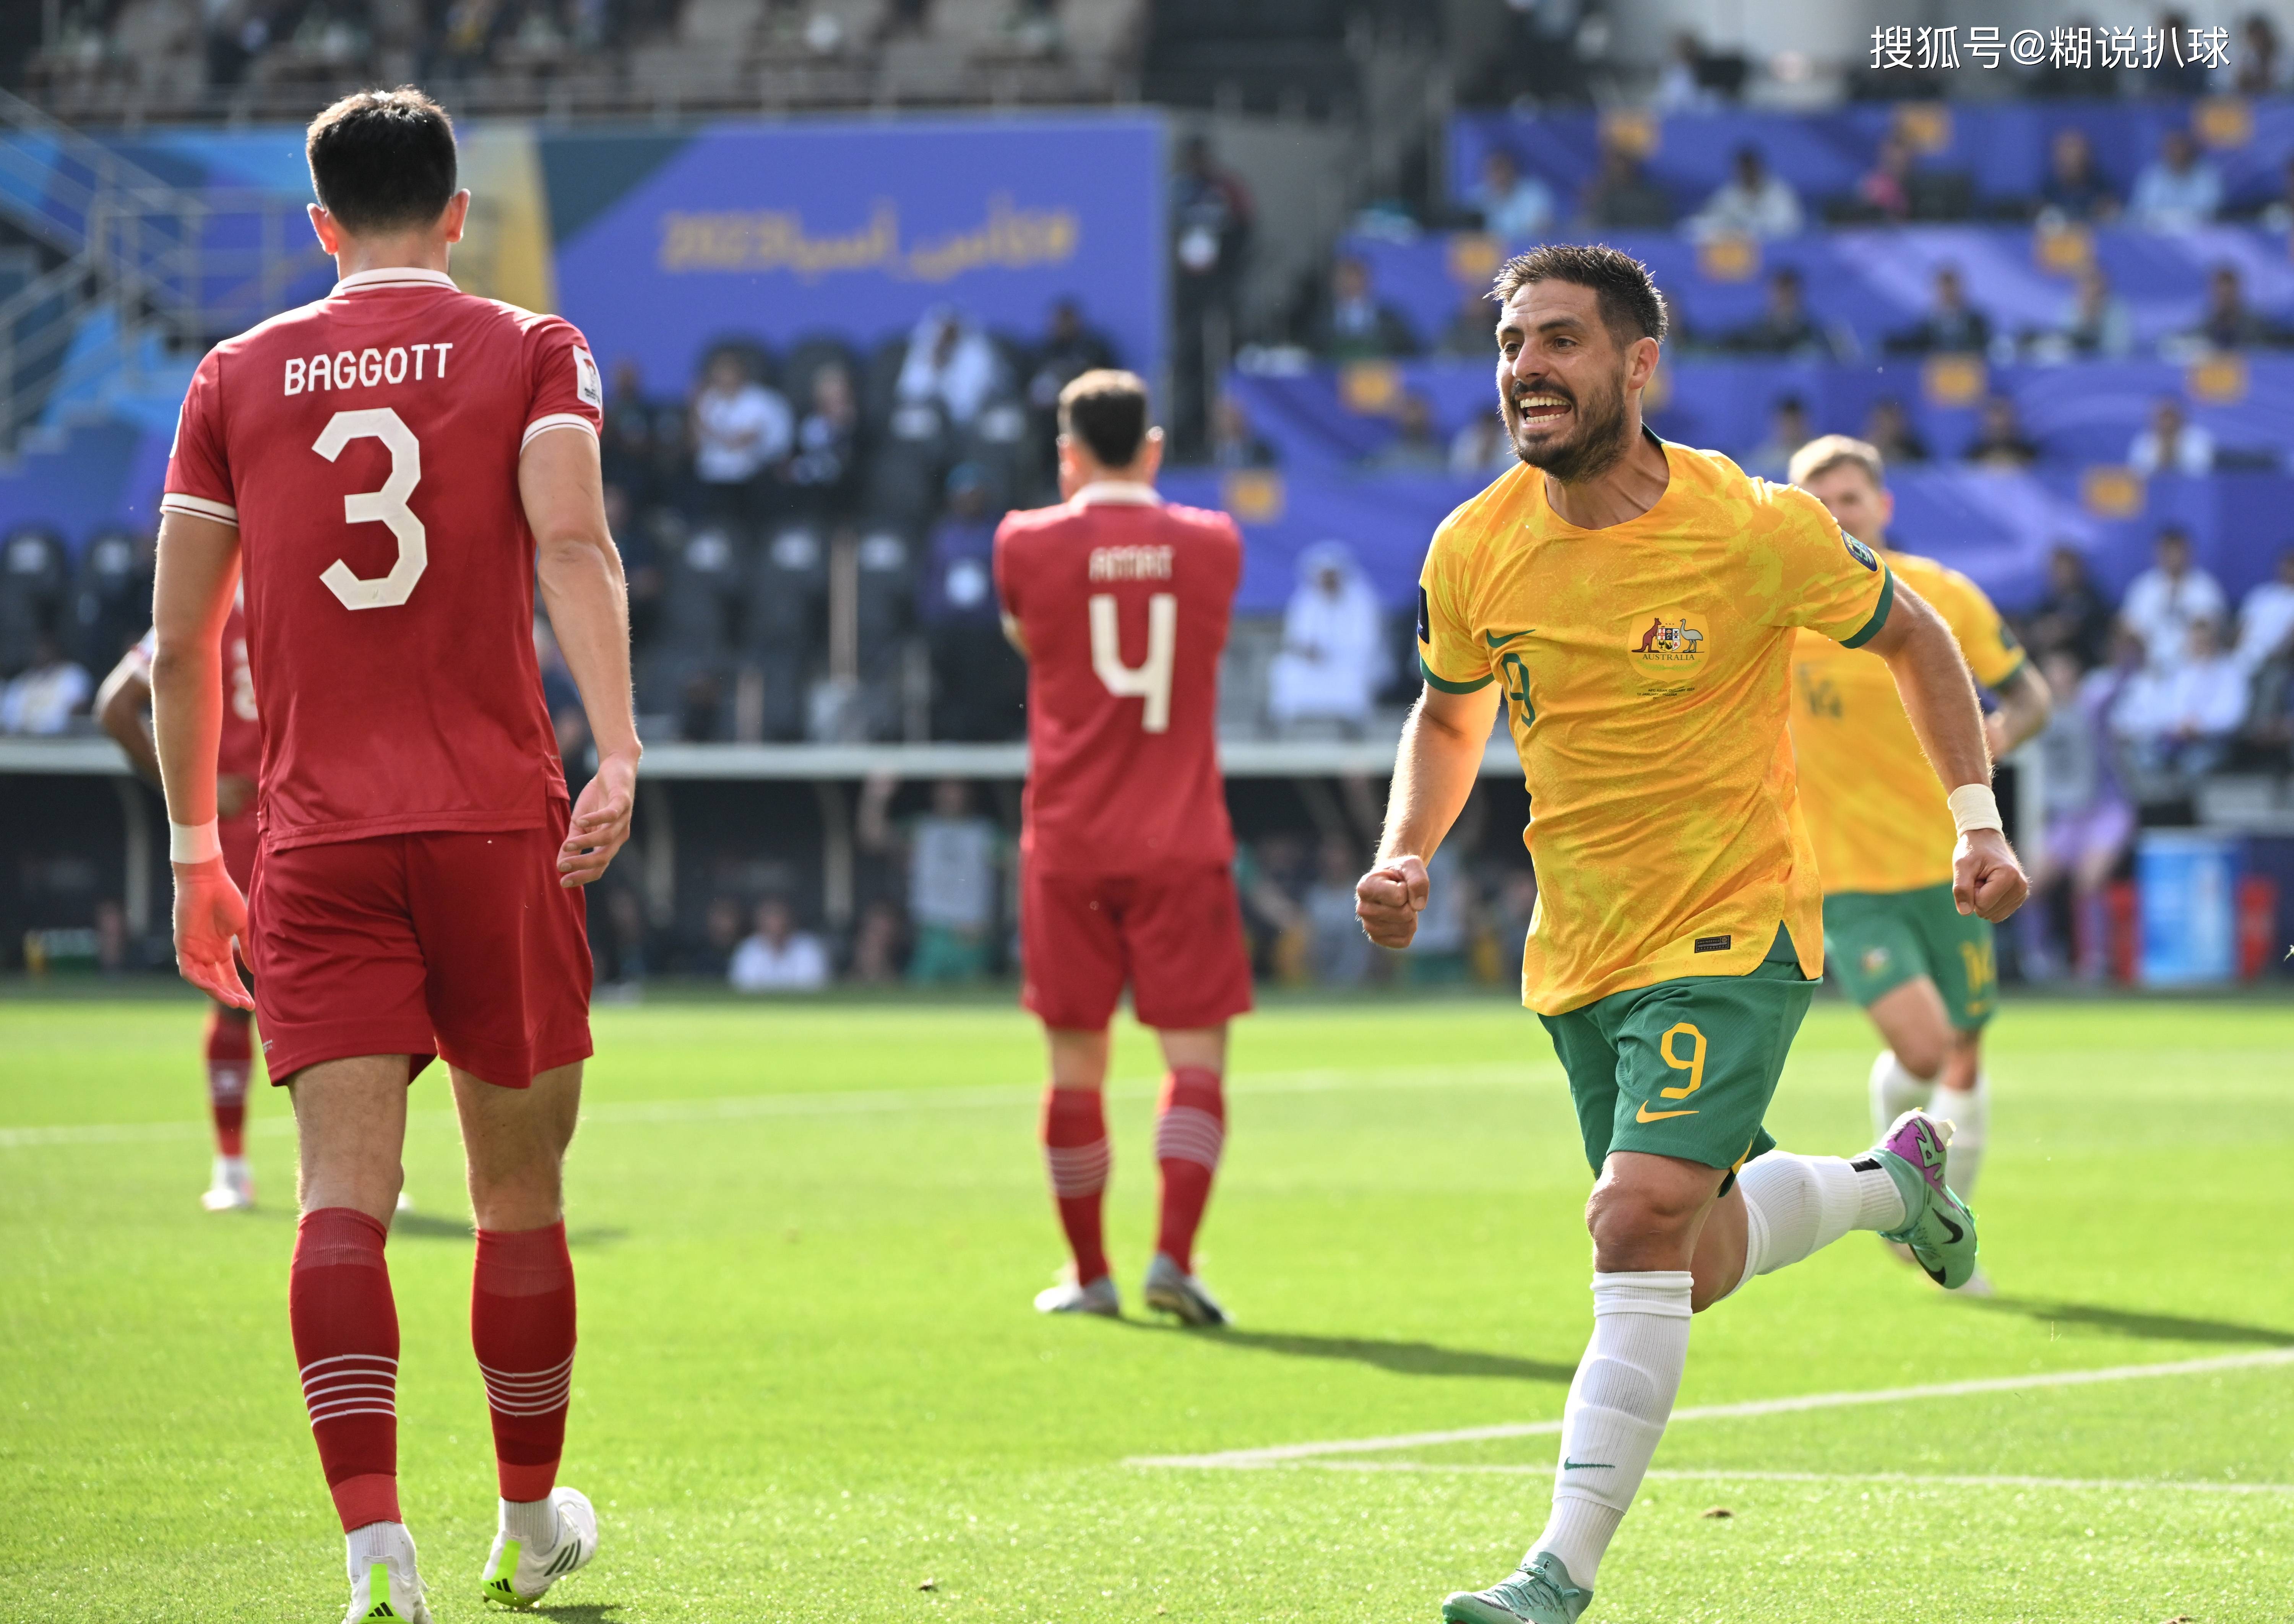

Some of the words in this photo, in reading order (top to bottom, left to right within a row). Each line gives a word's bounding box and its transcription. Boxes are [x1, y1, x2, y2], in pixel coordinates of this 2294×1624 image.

[284, 343, 453, 396] BAGGOTT
[312, 408, 427, 610] 3
[1089, 593, 1177, 732] 4
[1501, 653, 1536, 728] 9
[1660, 1022, 1706, 1099] 9
